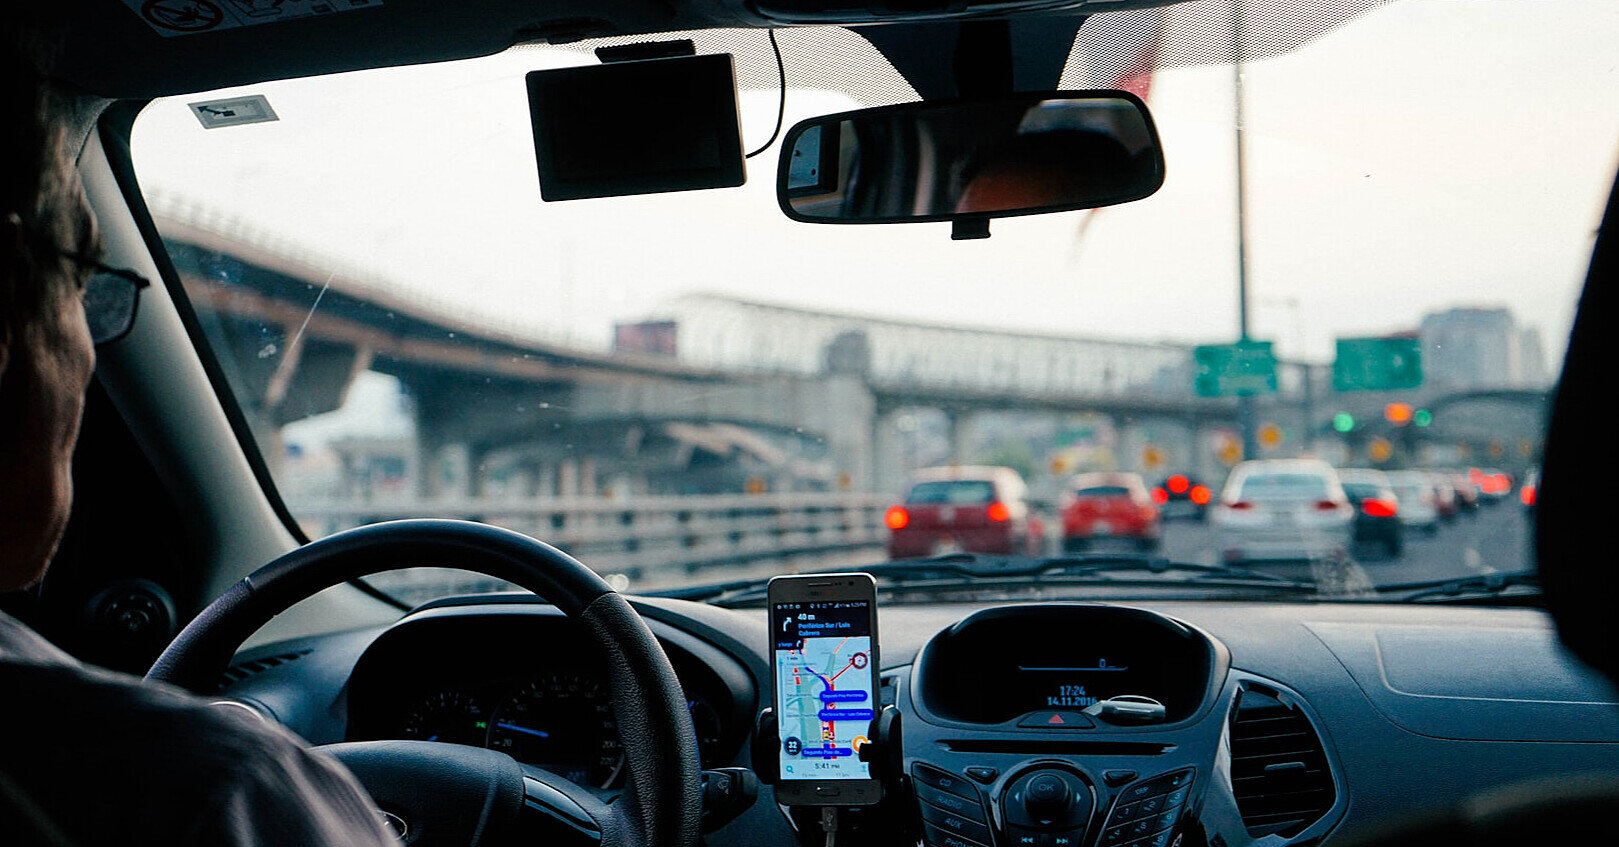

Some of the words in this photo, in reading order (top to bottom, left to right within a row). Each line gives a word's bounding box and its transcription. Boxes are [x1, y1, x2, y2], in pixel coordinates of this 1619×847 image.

[1060, 685, 1086, 695] 17:24
[1047, 696, 1097, 706] 14.11.2016
[939, 778, 952, 787] CD
[1039, 783, 1055, 792] OK
[937, 796, 962, 809] RADIO
[944, 818, 962, 829] AUX
